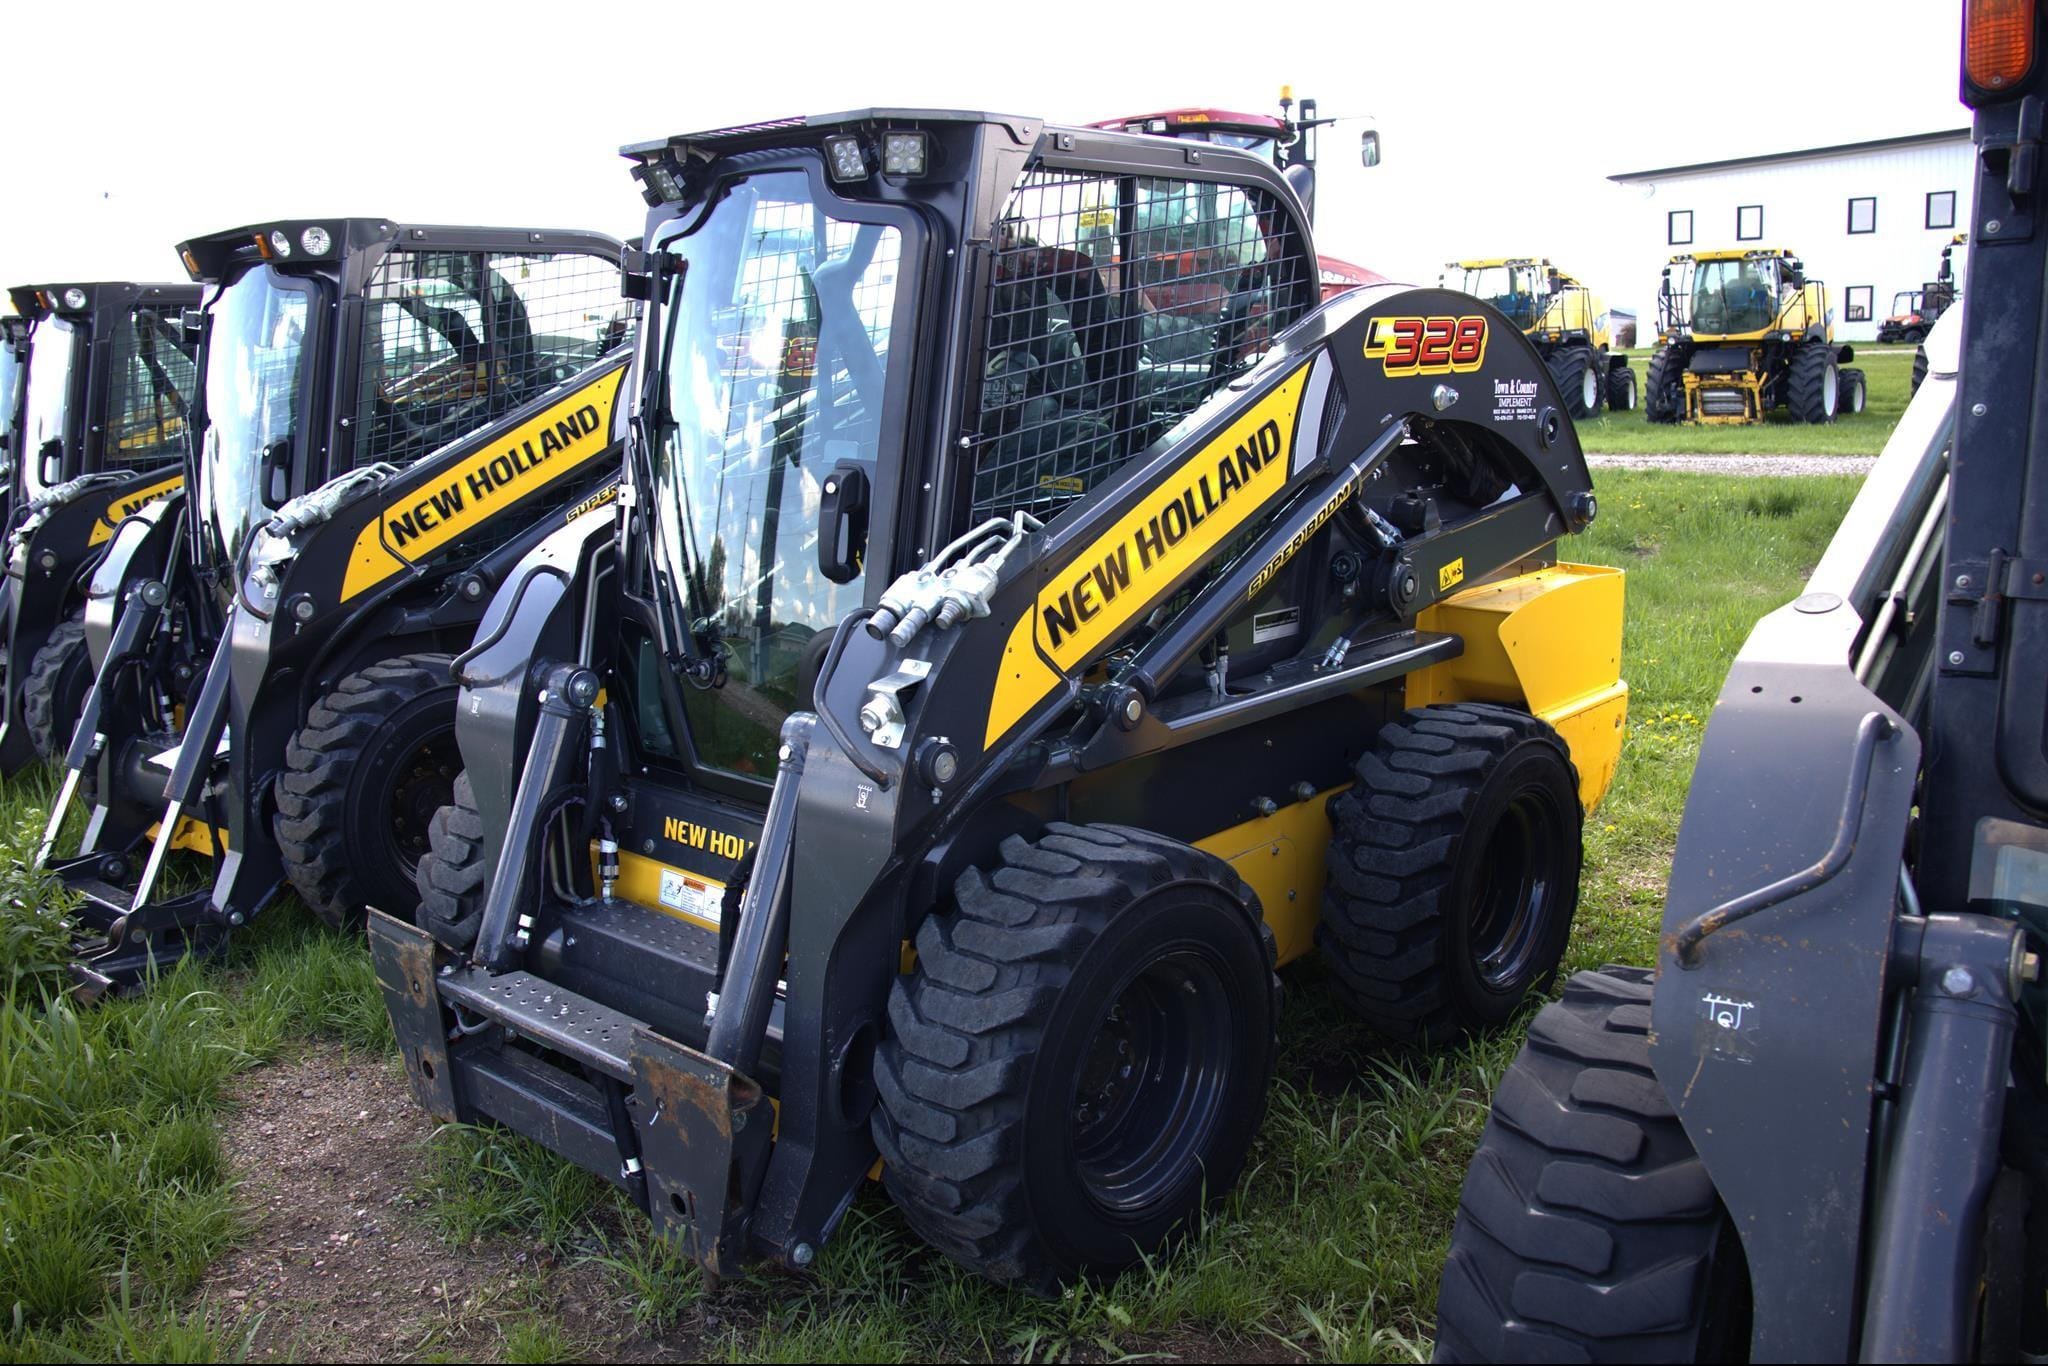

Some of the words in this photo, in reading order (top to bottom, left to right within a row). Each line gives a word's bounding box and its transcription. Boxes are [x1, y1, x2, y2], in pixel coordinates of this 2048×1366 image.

[1365, 318, 1488, 376] L328
[1494, 379, 1509, 394] Town
[1510, 379, 1515, 394] &
[1516, 379, 1537, 397] Country
[1498, 398, 1532, 407] IMPLEMENT
[388, 482, 465, 547] NEW
[465, 404, 600, 501] HOLLAND
[1042, 541, 1132, 651] NEW
[1134, 418, 1282, 574] HOLLAND
[664, 816, 707, 849] NEW
